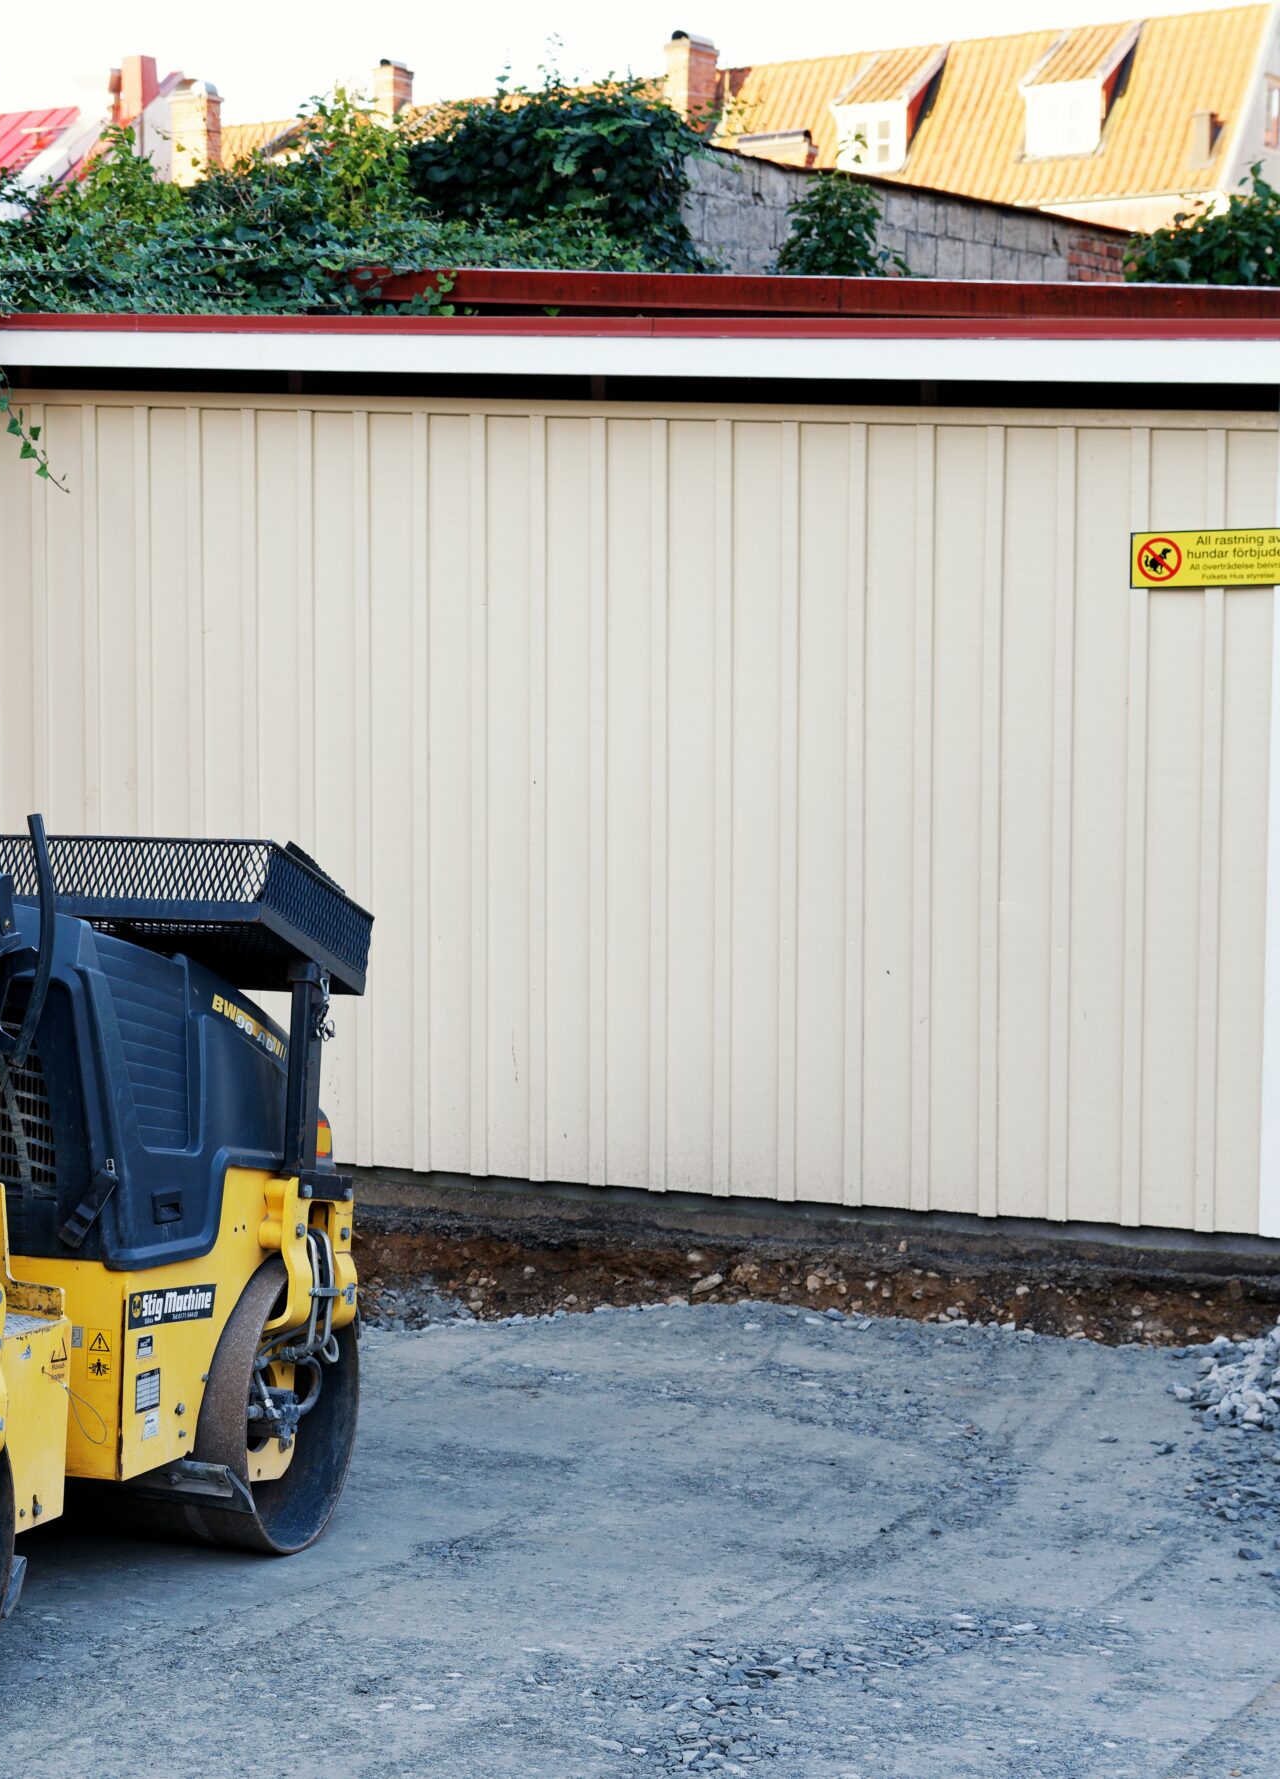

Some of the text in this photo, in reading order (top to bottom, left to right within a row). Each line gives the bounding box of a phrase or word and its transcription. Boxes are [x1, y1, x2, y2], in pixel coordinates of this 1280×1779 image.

[1196, 536, 1211, 546] All
[1215, 535, 1265, 547] rastning
[1187, 549, 1228, 559] hundar
[1189, 563, 1200, 571] All
[1202, 561, 1254, 571] överträdelse
[1202, 573, 1228, 581] Folkets
[1246, 572, 1275, 581] styrelse
[142, 1288, 212, 1321] Stig Machine
